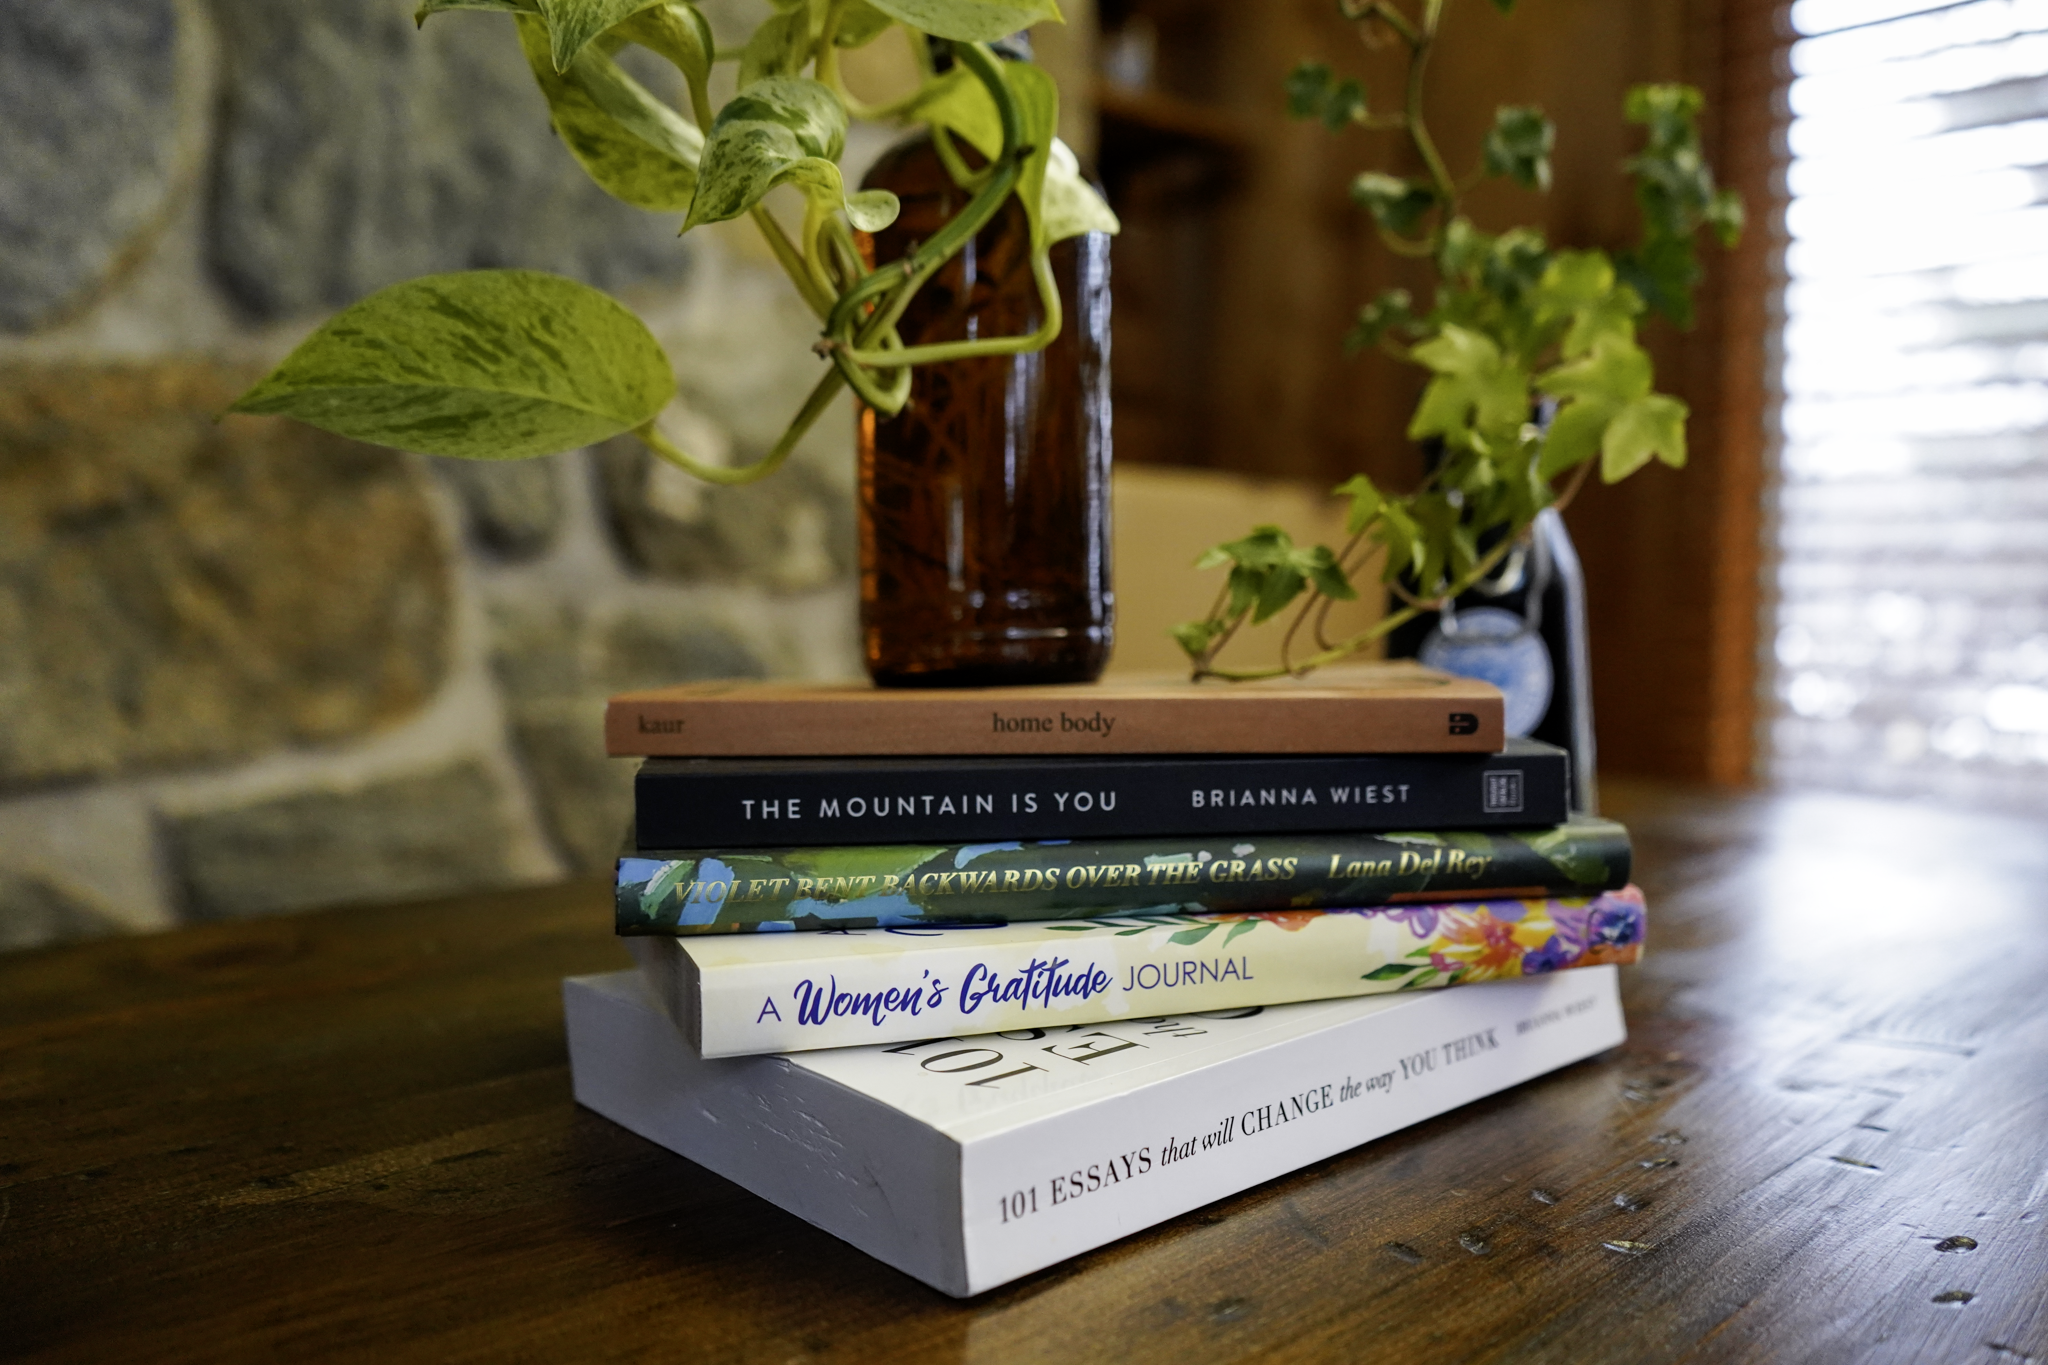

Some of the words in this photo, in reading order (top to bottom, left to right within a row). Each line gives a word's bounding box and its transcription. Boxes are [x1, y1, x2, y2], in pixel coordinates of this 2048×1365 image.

[638, 714, 685, 735] kaur
[993, 712, 1053, 733] home
[1060, 712, 1115, 738] body
[742, 798, 802, 820] THE
[819, 794, 993, 819] MOUNTAIN
[1012, 793, 1037, 813] IS
[1054, 791, 1116, 812] YOU
[1191, 788, 1317, 808] BRIANNA
[1330, 784, 1411, 805] WIEST
[1327, 853, 1393, 879] Lana
[1398, 848, 1443, 876] Del
[1446, 848, 1492, 881] Rey
[673, 877, 790, 905] VIOLET
[796, 874, 876, 902] BENT
[881, 867, 1061, 898] BACKWARDS
[1065, 863, 1142, 889] OVER
[1146, 861, 1204, 886] THE
[1208, 856, 1299, 884] GRASS
[757, 996, 782, 1024] A
[793, 969, 949, 1026] Women's
[959, 956, 1113, 1014] Gratitude
[1122, 956, 1254, 991] JOURNAL
[998, 1186, 1039, 1225] 101
[1050, 1147, 1152, 1207] ESSAYS
[1160, 1136, 1199, 1167] that
[1201, 1116, 1235, 1152] will
[1240, 1084, 1335, 1137] CHANGE
[1339, 1076, 1364, 1103] the
[1365, 1069, 1397, 1094] way
[1399, 1047, 1438, 1082] YOU
[1441, 1028, 1499, 1067] THINK
